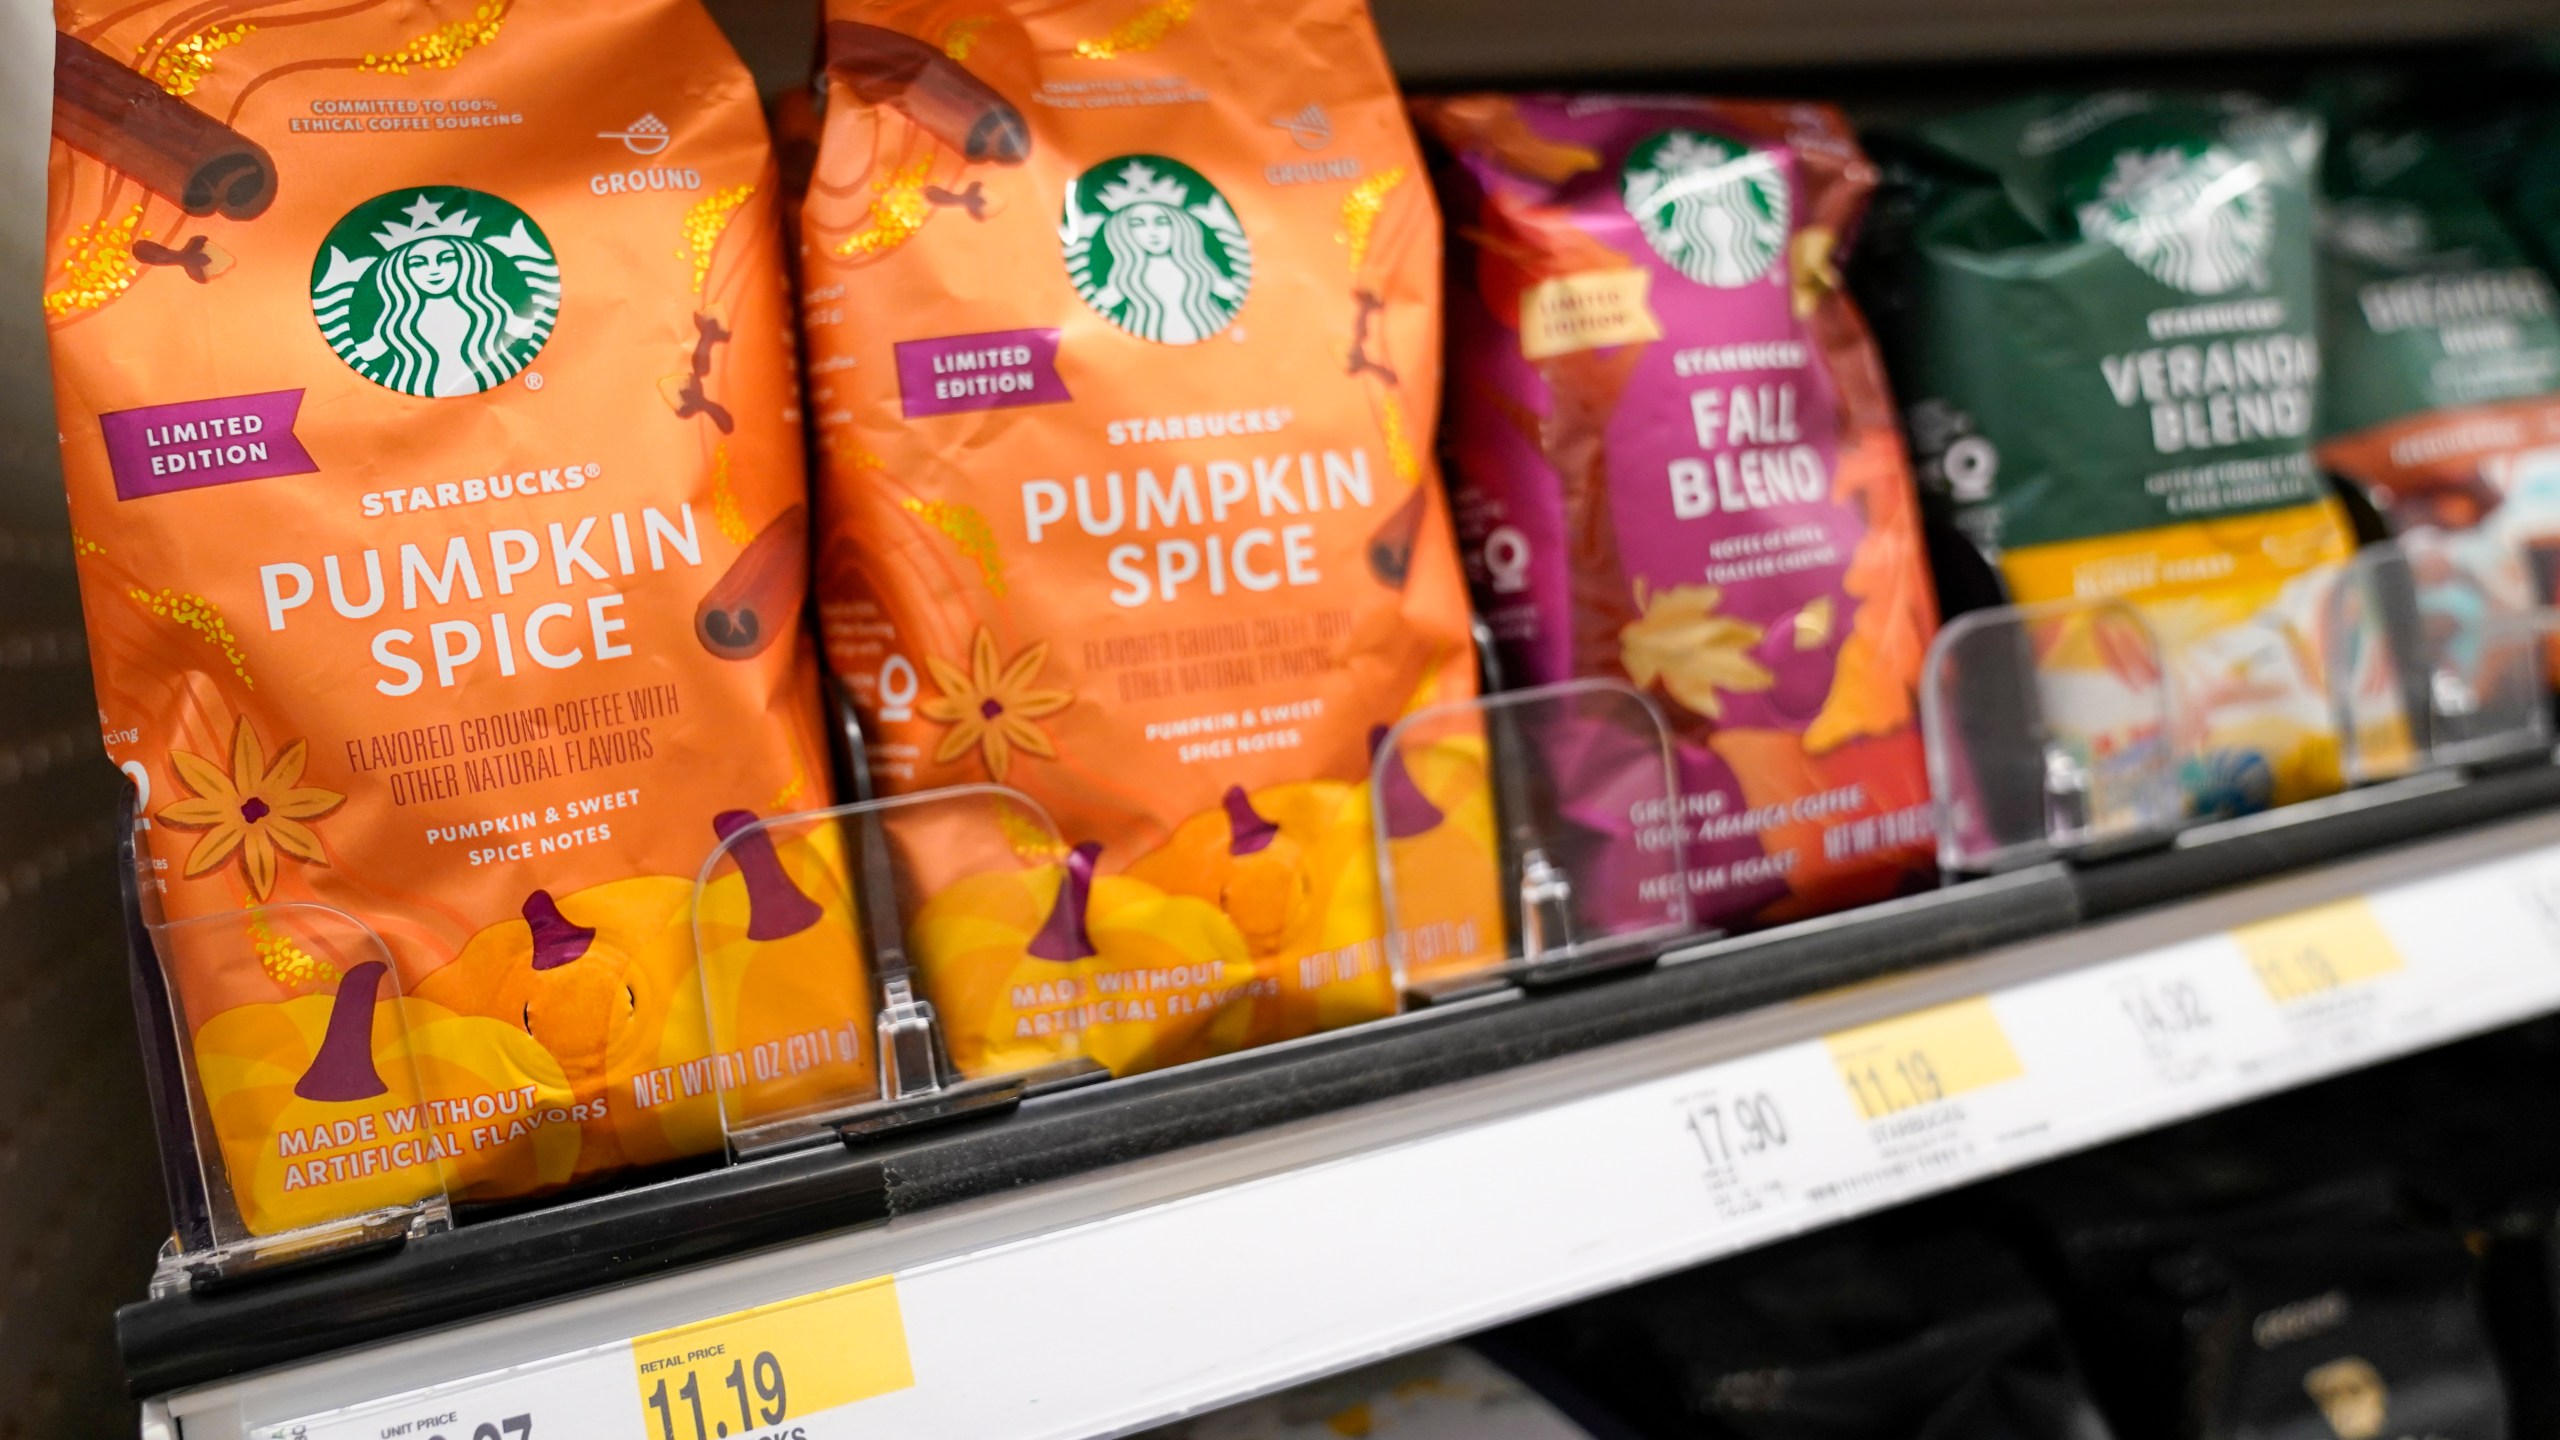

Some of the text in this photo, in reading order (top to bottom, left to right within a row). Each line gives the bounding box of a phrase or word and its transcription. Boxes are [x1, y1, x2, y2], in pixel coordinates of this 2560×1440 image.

[291, 114, 523, 131] ETHICAL COFFEE SOURCING
[312, 100, 498, 113] COMMITTED TO 100%
[590, 168, 700, 196] GROUND
[932, 346, 1032, 374] LIMITED
[936, 372, 1034, 400] EDITION
[147, 415, 262, 447] LIMITED
[1689, 382, 1799, 449] FALL
[2150, 386, 2313, 454] BLEND
[152, 442, 268, 476] EDITION
[1668, 445, 1826, 520] BLEND
[1022, 449, 1373, 543] PUMPKIN
[260, 503, 702, 631] PUMPKIN
[1108, 525, 1321, 608] SPICE
[371, 594, 632, 696] SPICE
[345, 684, 680, 773] FLAVORED GROUND COFFEE WITH
[1145, 712, 1237, 741] PUMPKIN
[1261, 698, 1324, 725] SWEET
[1178, 729, 1301, 763] SPICE NOTES
[391, 728, 654, 807] OTHER NATURAL FLAVORS
[426, 789, 640, 845] PUMPKIN & SWEET
[1699, 805, 1786, 841] ARABICA
[1791, 783, 1865, 821] COFFEE
[469, 824, 611, 866] SPICE NOTES
[1731, 848, 1797, 882] ROAST
[1096, 960, 1224, 993] WITHOUT
[633, 1067, 675, 1109] NET
[679, 1055, 714, 1097] WT
[753, 1041, 783, 1082] OZ
[787, 1028, 832, 1076] (311
[836, 1018, 859, 1063] g)
[1847, 1049, 1945, 1120] 11.19
[280, 1086, 539, 1158] MADE WITHOUT
[284, 1098, 608, 1192] ARTIFICIAL FLAVORS
[1685, 1089, 1788, 1166] 17.90
[640, 1344, 726, 1374] RETAIL PRICE
[648, 1351, 787, 1440] 11.19
[381, 1422, 414, 1440] UNIT
[417, 1411, 457, 1431] PRICE
